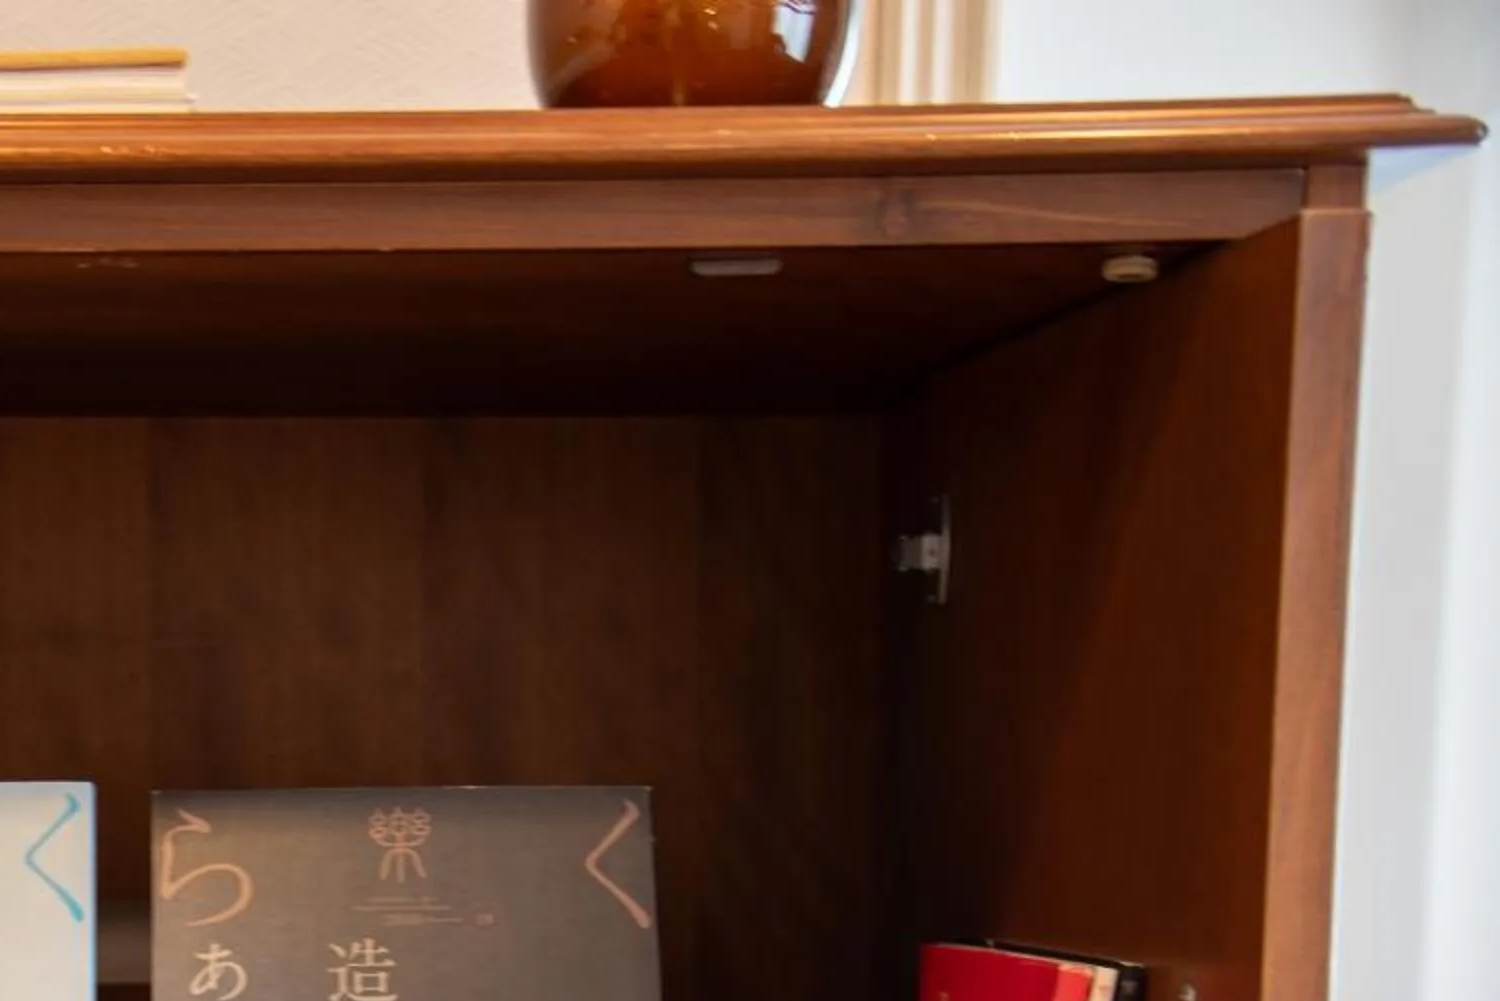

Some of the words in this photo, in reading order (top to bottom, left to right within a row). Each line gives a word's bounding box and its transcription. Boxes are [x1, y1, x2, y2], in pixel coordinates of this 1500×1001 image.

[24, 793, 85, 923] く
[159, 808, 255, 928] ら
[583, 798, 652, 929] く
